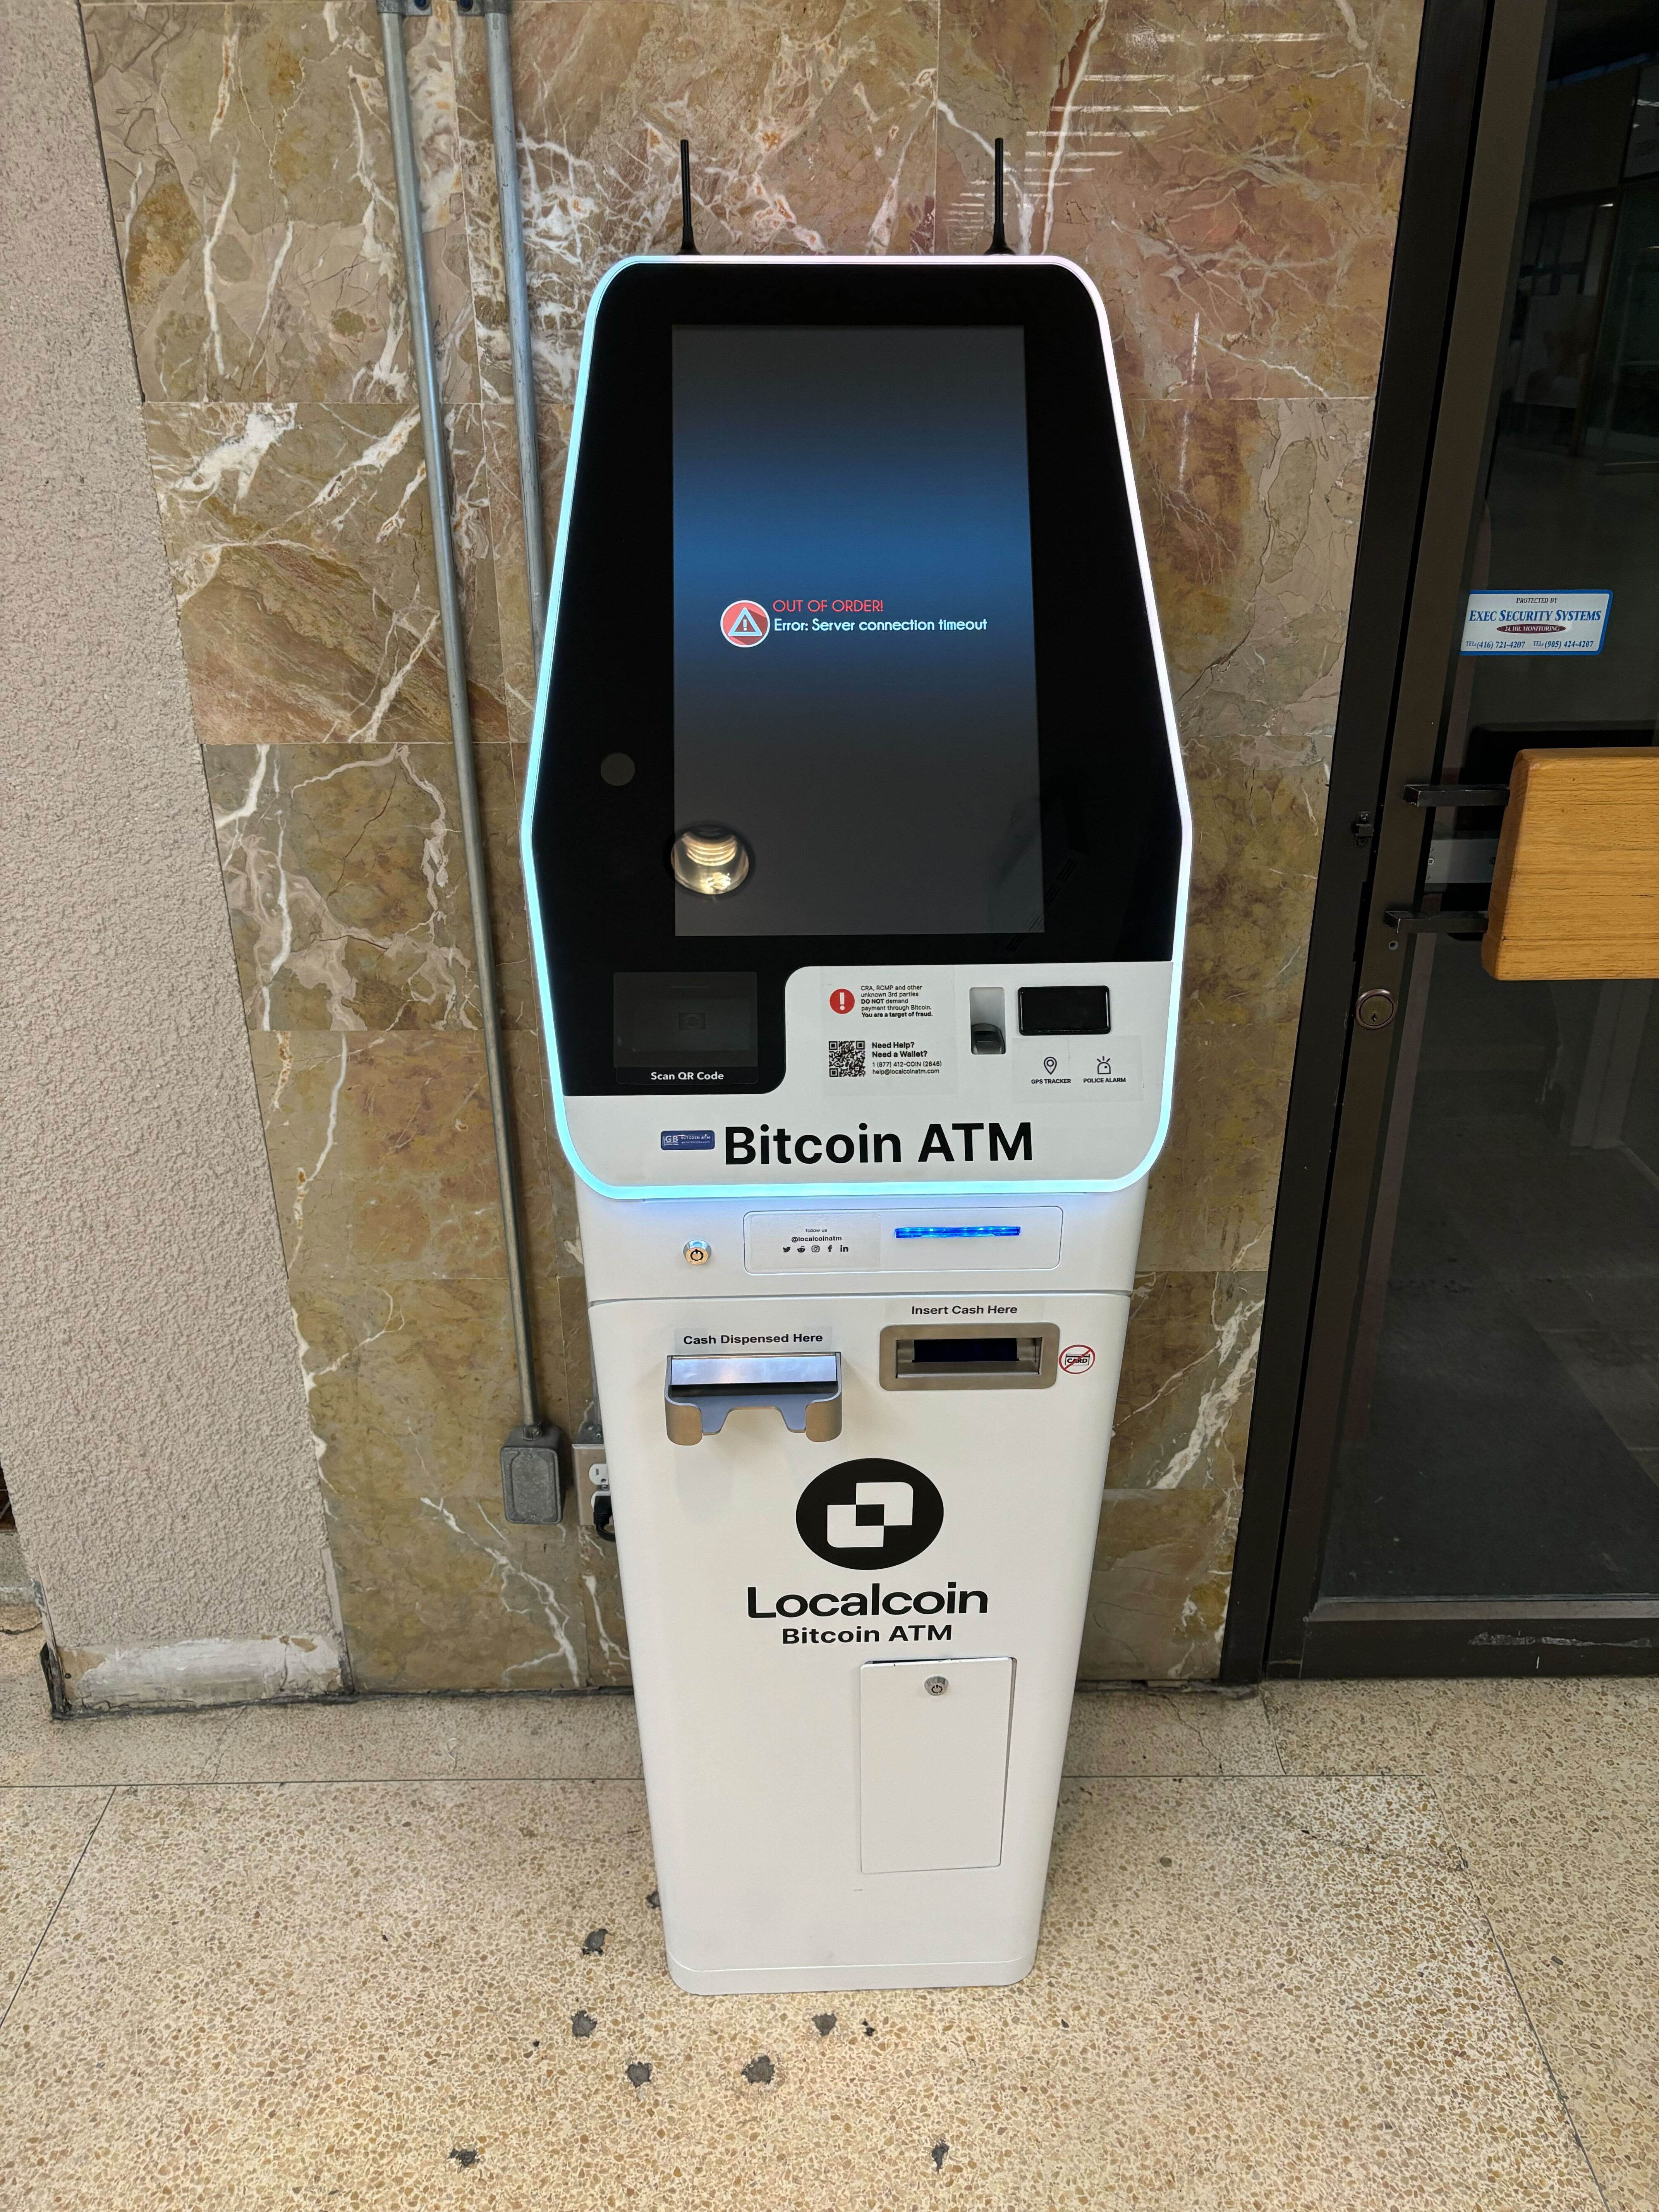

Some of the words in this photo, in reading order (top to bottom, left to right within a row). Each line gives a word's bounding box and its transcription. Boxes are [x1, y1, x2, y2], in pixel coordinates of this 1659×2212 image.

[773, 600, 803, 612] OUT
[807, 600, 828, 612] OF
[831, 600, 883, 612] ORDER!
[1469, 610, 1497, 622] EXEC
[1499, 610, 1552, 621] SECURITY
[1555, 610, 1601, 621] SYSTEMS
[774, 618, 809, 631] Error:
[812, 618, 855, 631] Server
[859, 618, 934, 631] connection
[938, 618, 988, 631] timeout
[1477, 641, 1493, 649] (416)
[1545, 641, 1561, 649] (905)
[893, 1041, 915, 1049] Help?
[651, 1072, 675, 1080] Scan
[678, 1072, 694, 1080] QR
[697, 1071, 724, 1080] Code
[725, 1122, 902, 1165] Bitcoin
[917, 1122, 1033, 1162] ATM
[911, 1305, 948, 1315] Insert
[951, 1305, 985, 1315] Cash
[988, 1305, 1018, 1314] Here
[683, 1335, 717, 1345] Cash
[720, 1334, 789, 1346] Dispensed
[792, 1333, 823, 1343] Here
[747, 1582, 988, 1618] Localcoin
[782, 1626, 879, 1644] Bitcoin
[888, 1625, 952, 1642] ATM
